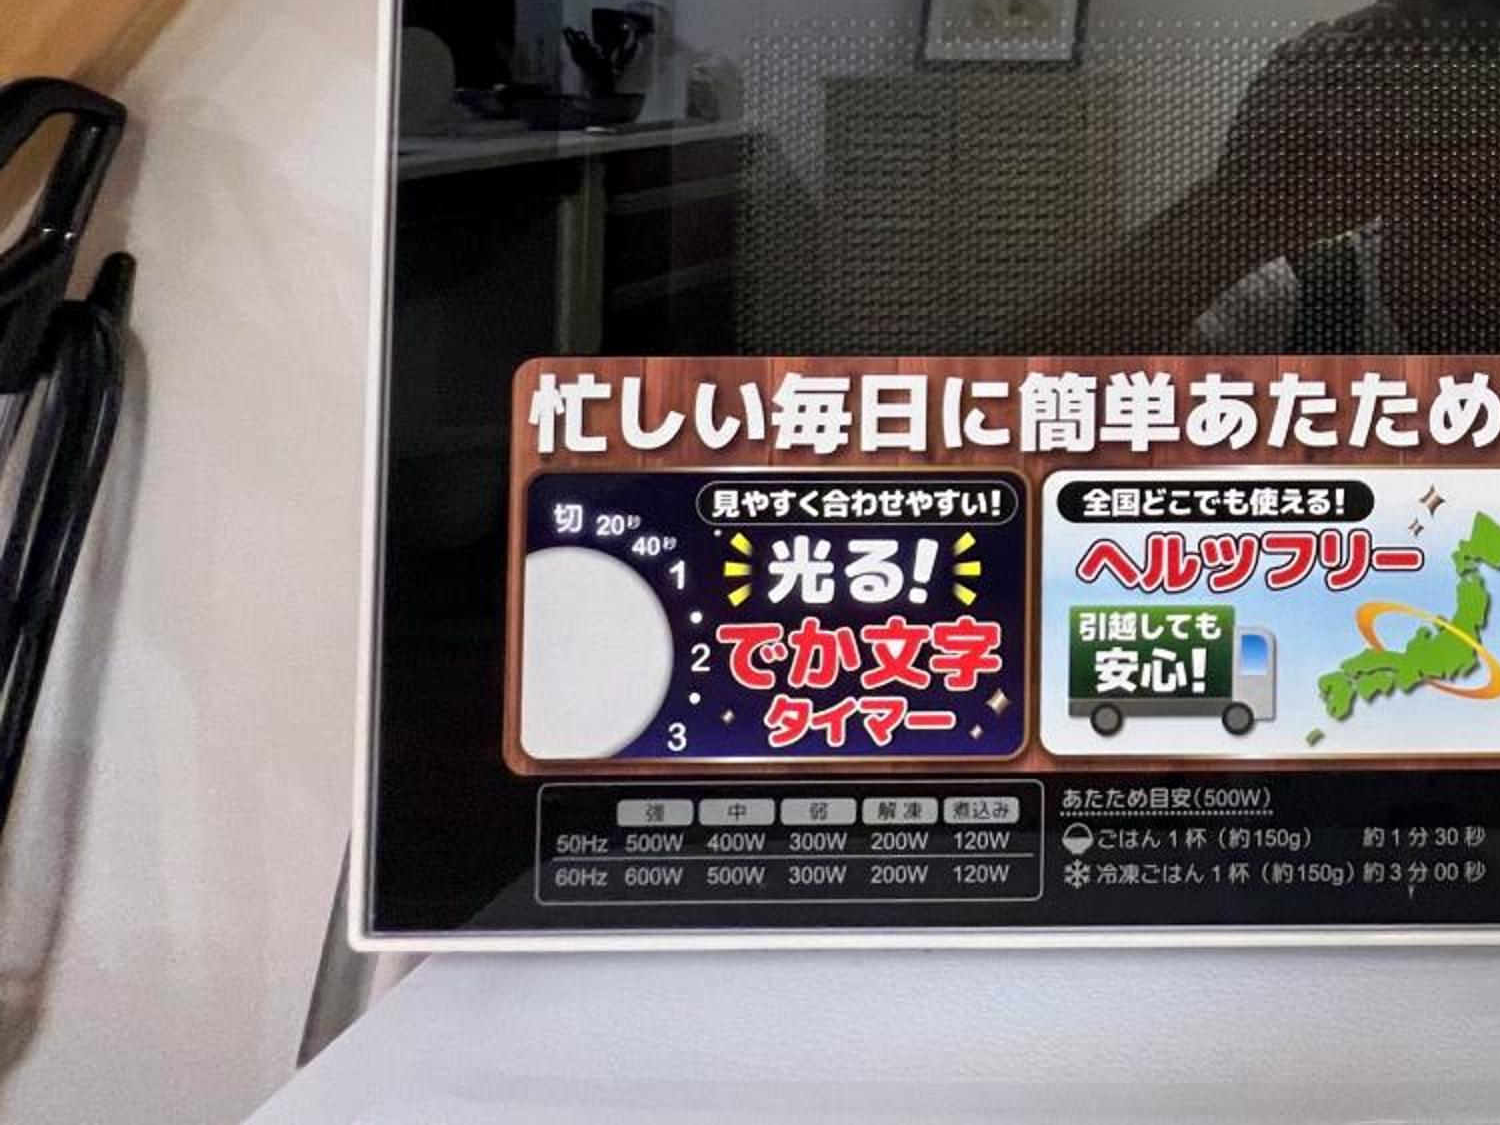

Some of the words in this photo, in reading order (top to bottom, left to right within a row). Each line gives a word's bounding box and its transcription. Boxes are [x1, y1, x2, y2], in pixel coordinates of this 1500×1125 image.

[712, 489, 1002, 519] 見やすく合わせやすい！
[1083, 488, 1346, 517] 全国どこでも使える！
[553, 504, 583, 534] 切
[596, 514, 641, 536] 20秒
[632, 535, 677, 556] 40秒
[669, 561, 686, 590] 1
[766, 537, 939, 605] 光る！
[1076, 530, 1423, 594] ヘルツフリー
[1078, 612, 1222, 641] 引越しても
[690, 645, 711, 672] 2
[716, 616, 1002, 691] でか文字
[1094, 647, 1208, 695] 安心！
[763, 694, 956, 748] タイマー
[667, 723, 687, 751] 3
[727, 802, 748, 822] 中
[876, 801, 923, 821] 解凍
[952, 800, 1009, 820] 煮込み
[555, 834, 609, 855] 50Hz
[624, 833, 685, 853] 500W
[706, 833, 766, 853] 400W
[788, 832, 848, 852] 300W
[870, 831, 930, 851] 200W
[952, 830, 1011, 850] 120W
[554, 867, 609, 887] 60Hz
[624, 866, 684, 886] 600W
[706, 865, 766, 885] 500W
[788, 865, 848, 885] 300W
[870, 864, 929, 884] 200W
[952, 863, 1011, 883] 120W
